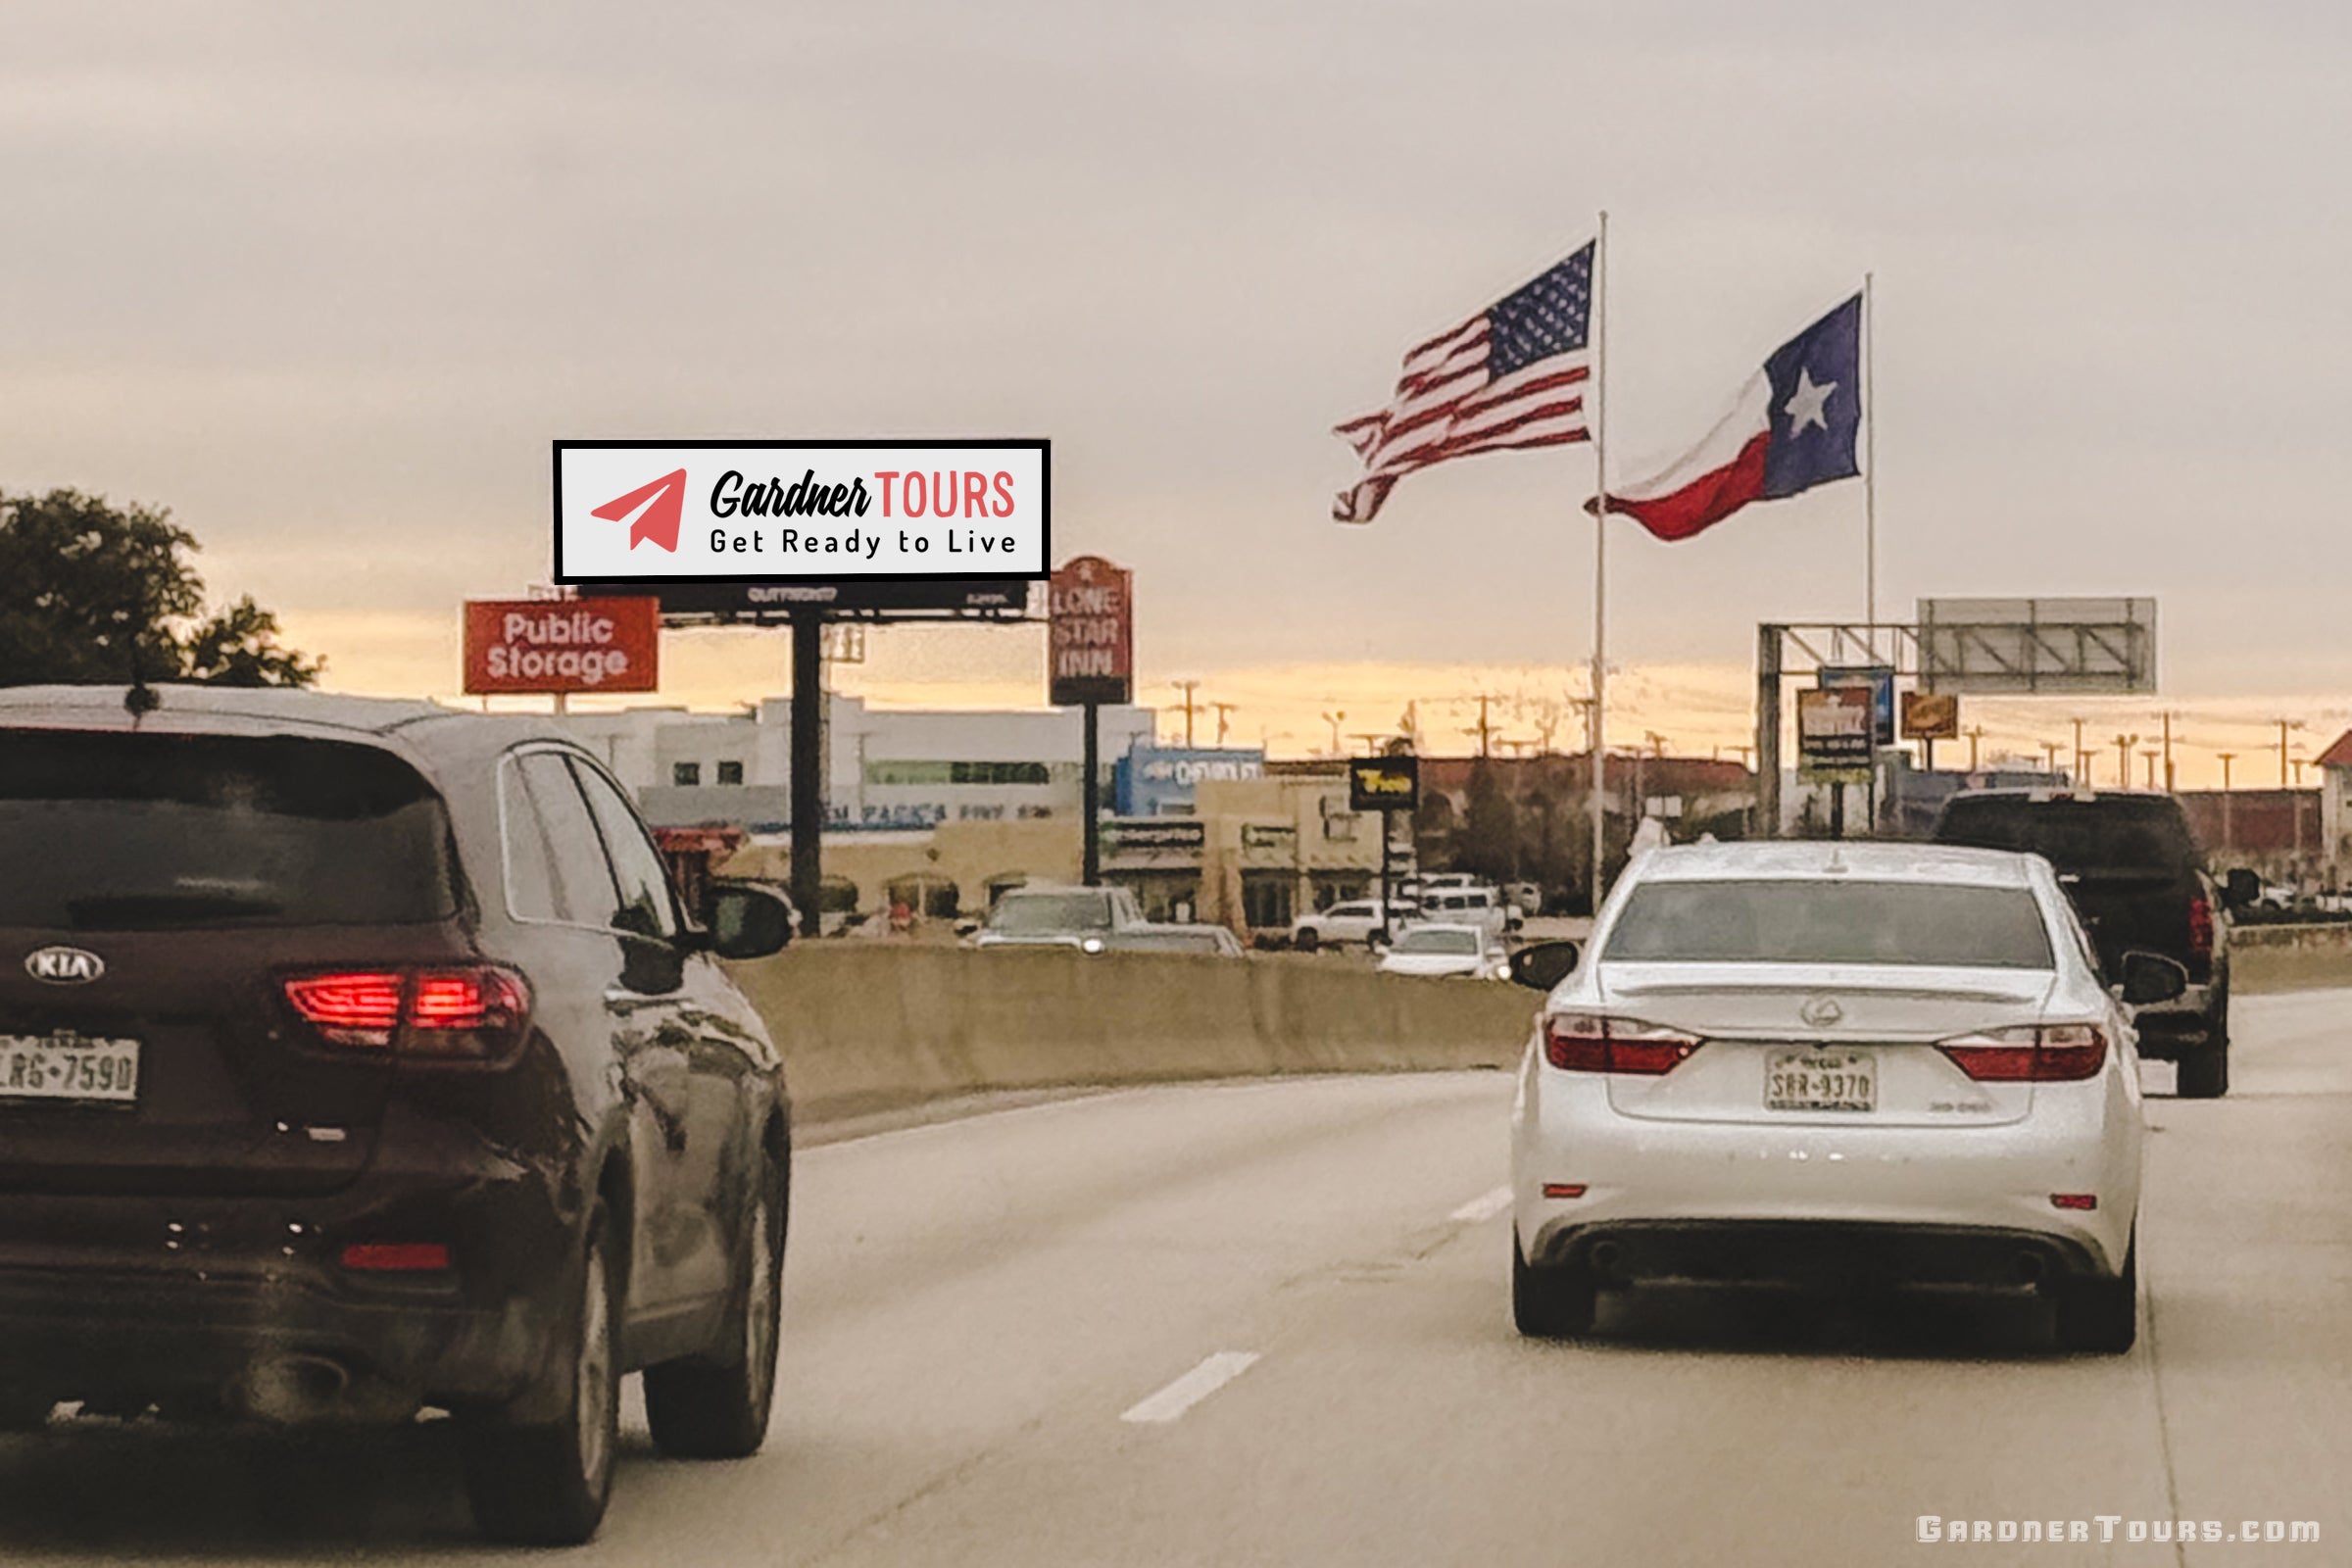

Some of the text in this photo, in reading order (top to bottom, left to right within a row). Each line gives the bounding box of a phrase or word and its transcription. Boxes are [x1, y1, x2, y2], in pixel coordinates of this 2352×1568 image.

[710, 468, 1015, 518] Gardner TOURS
[710, 528, 1015, 560] Get Ready to Live
[504, 612, 614, 644] Public
[1054, 617, 1118, 645] STAR
[487, 645, 628, 684] Storage
[1058, 649, 1113, 676] INN
[37, 951, 94, 980] KIA
